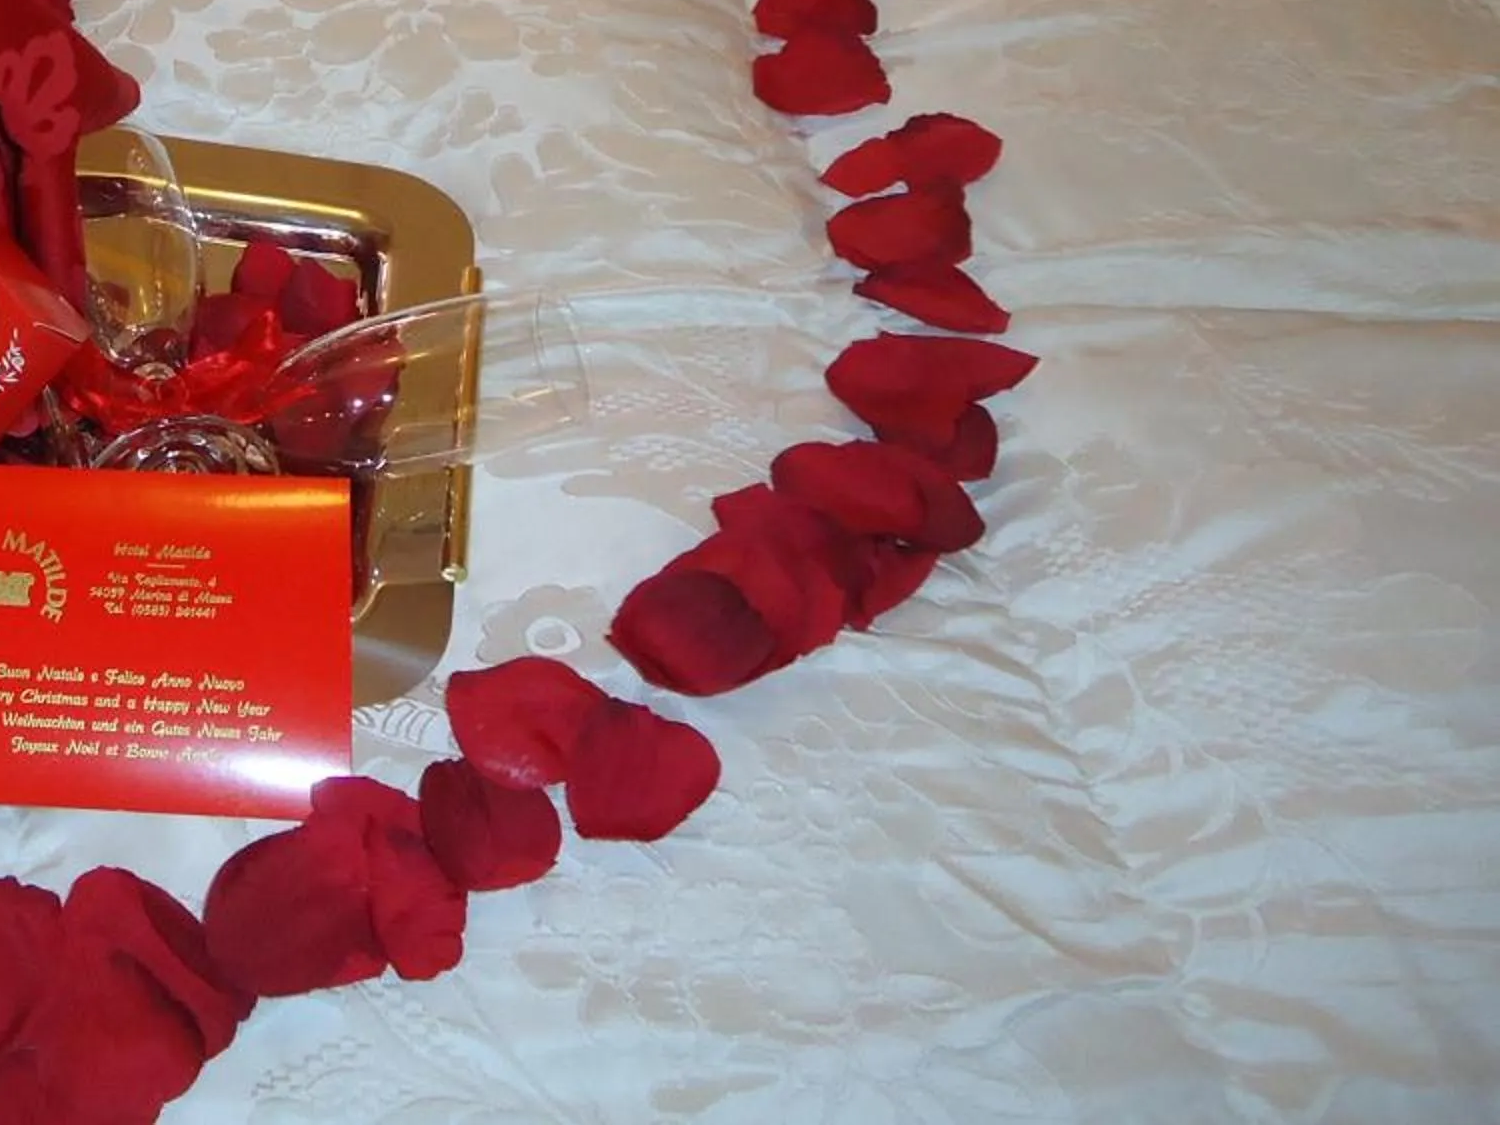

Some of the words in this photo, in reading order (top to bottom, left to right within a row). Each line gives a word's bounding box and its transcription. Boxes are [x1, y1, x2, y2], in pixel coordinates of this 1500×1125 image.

[113, 542, 150, 557] Hotel
[1, 528, 67, 624] MATILDE
[36, 664, 85, 682] Natale
[91, 672, 99, 682] e
[104, 668, 146, 686] Felice
[151, 672, 193, 689] Anno
[198, 673, 245, 692] Nuovo
[19, 687, 89, 707] Christmas
[94, 691, 122, 708] and
[126, 697, 137, 710] a
[143, 694, 191, 715] Happy
[196, 697, 231, 714] New
[237, 699, 272, 718] Year
[1, 710, 85, 730] Weihnachten
[91, 717, 120, 732] und
[124, 720, 145, 734] ein
[151, 719, 191, 737] Gutes
[197, 722, 241, 740] Neues
[11, 735, 60, 756] Joyeux
[105, 744, 120, 757] et
